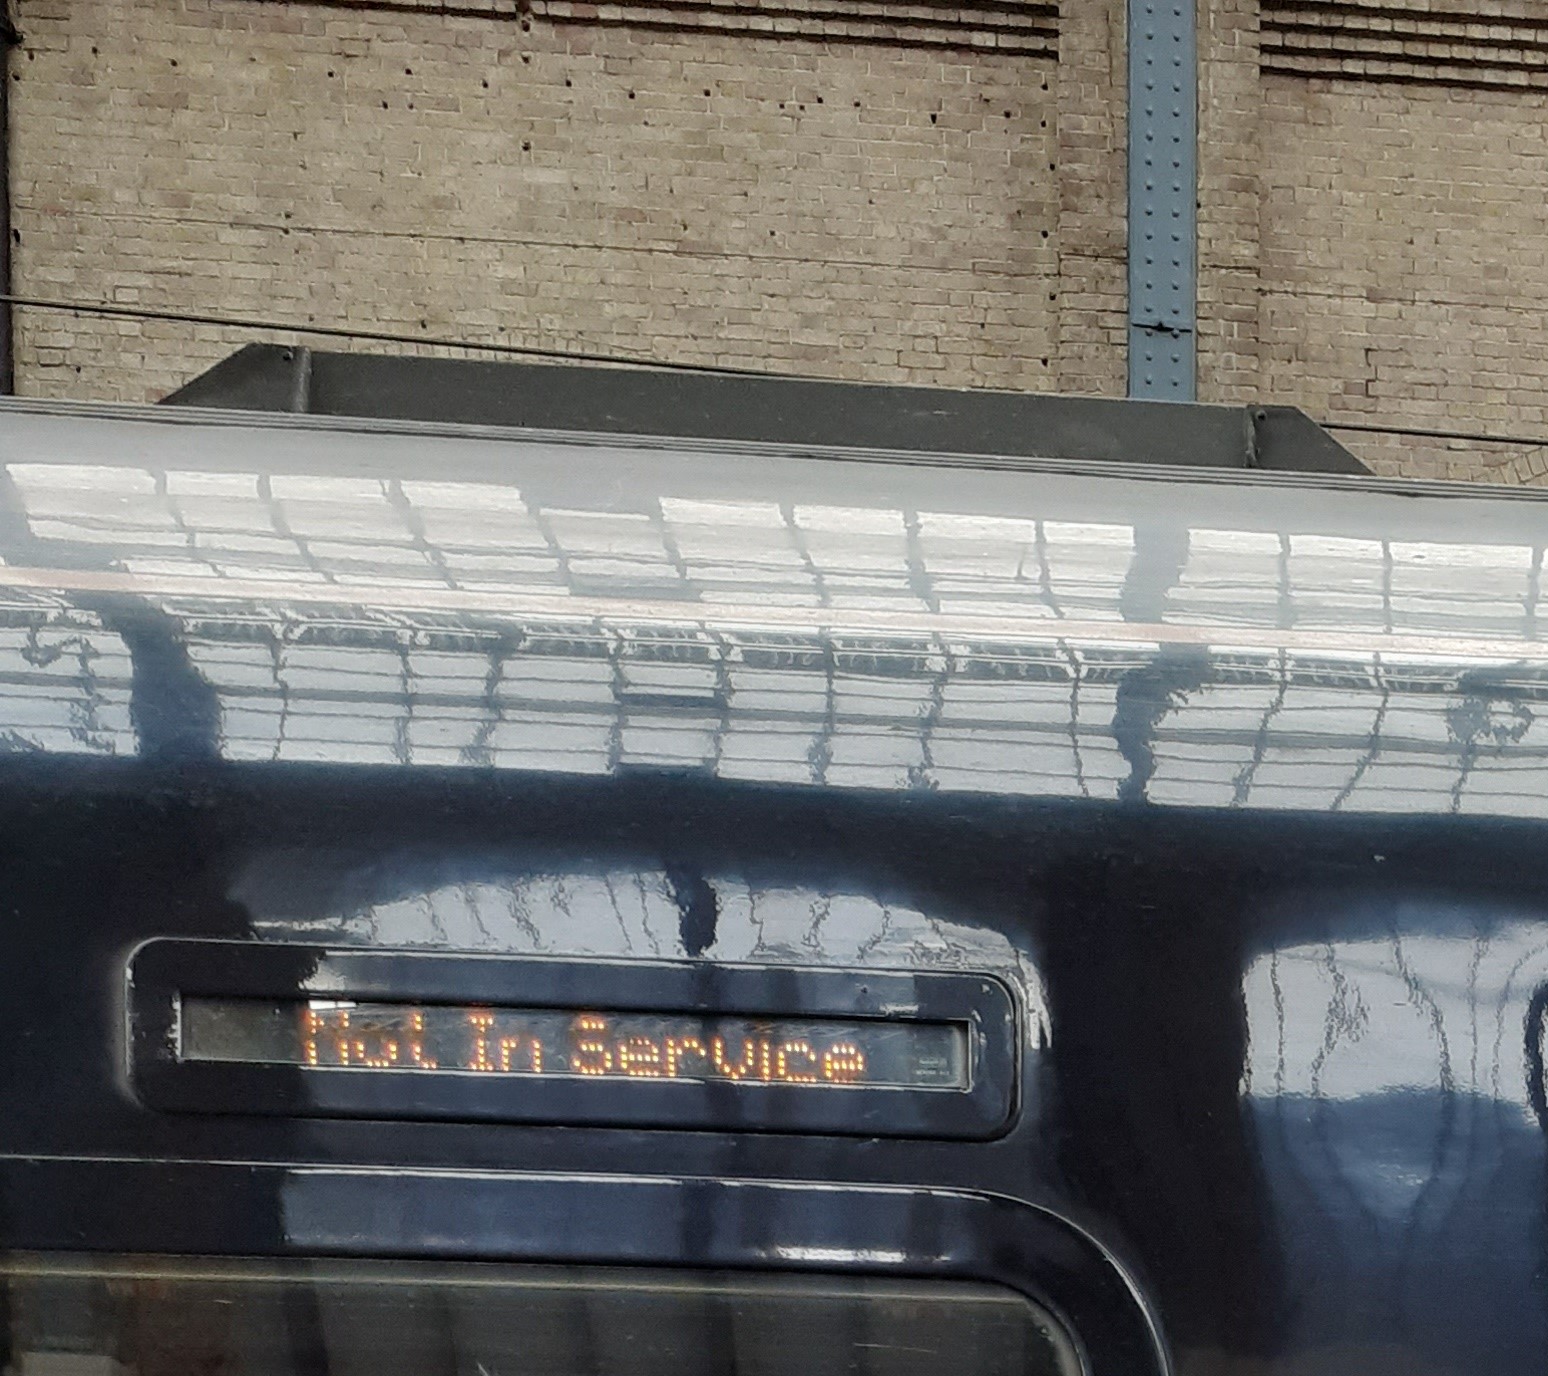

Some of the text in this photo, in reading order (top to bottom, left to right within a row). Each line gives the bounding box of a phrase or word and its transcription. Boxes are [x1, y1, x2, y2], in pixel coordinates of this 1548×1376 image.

[305, 1006, 866, 1084] Not In Service
